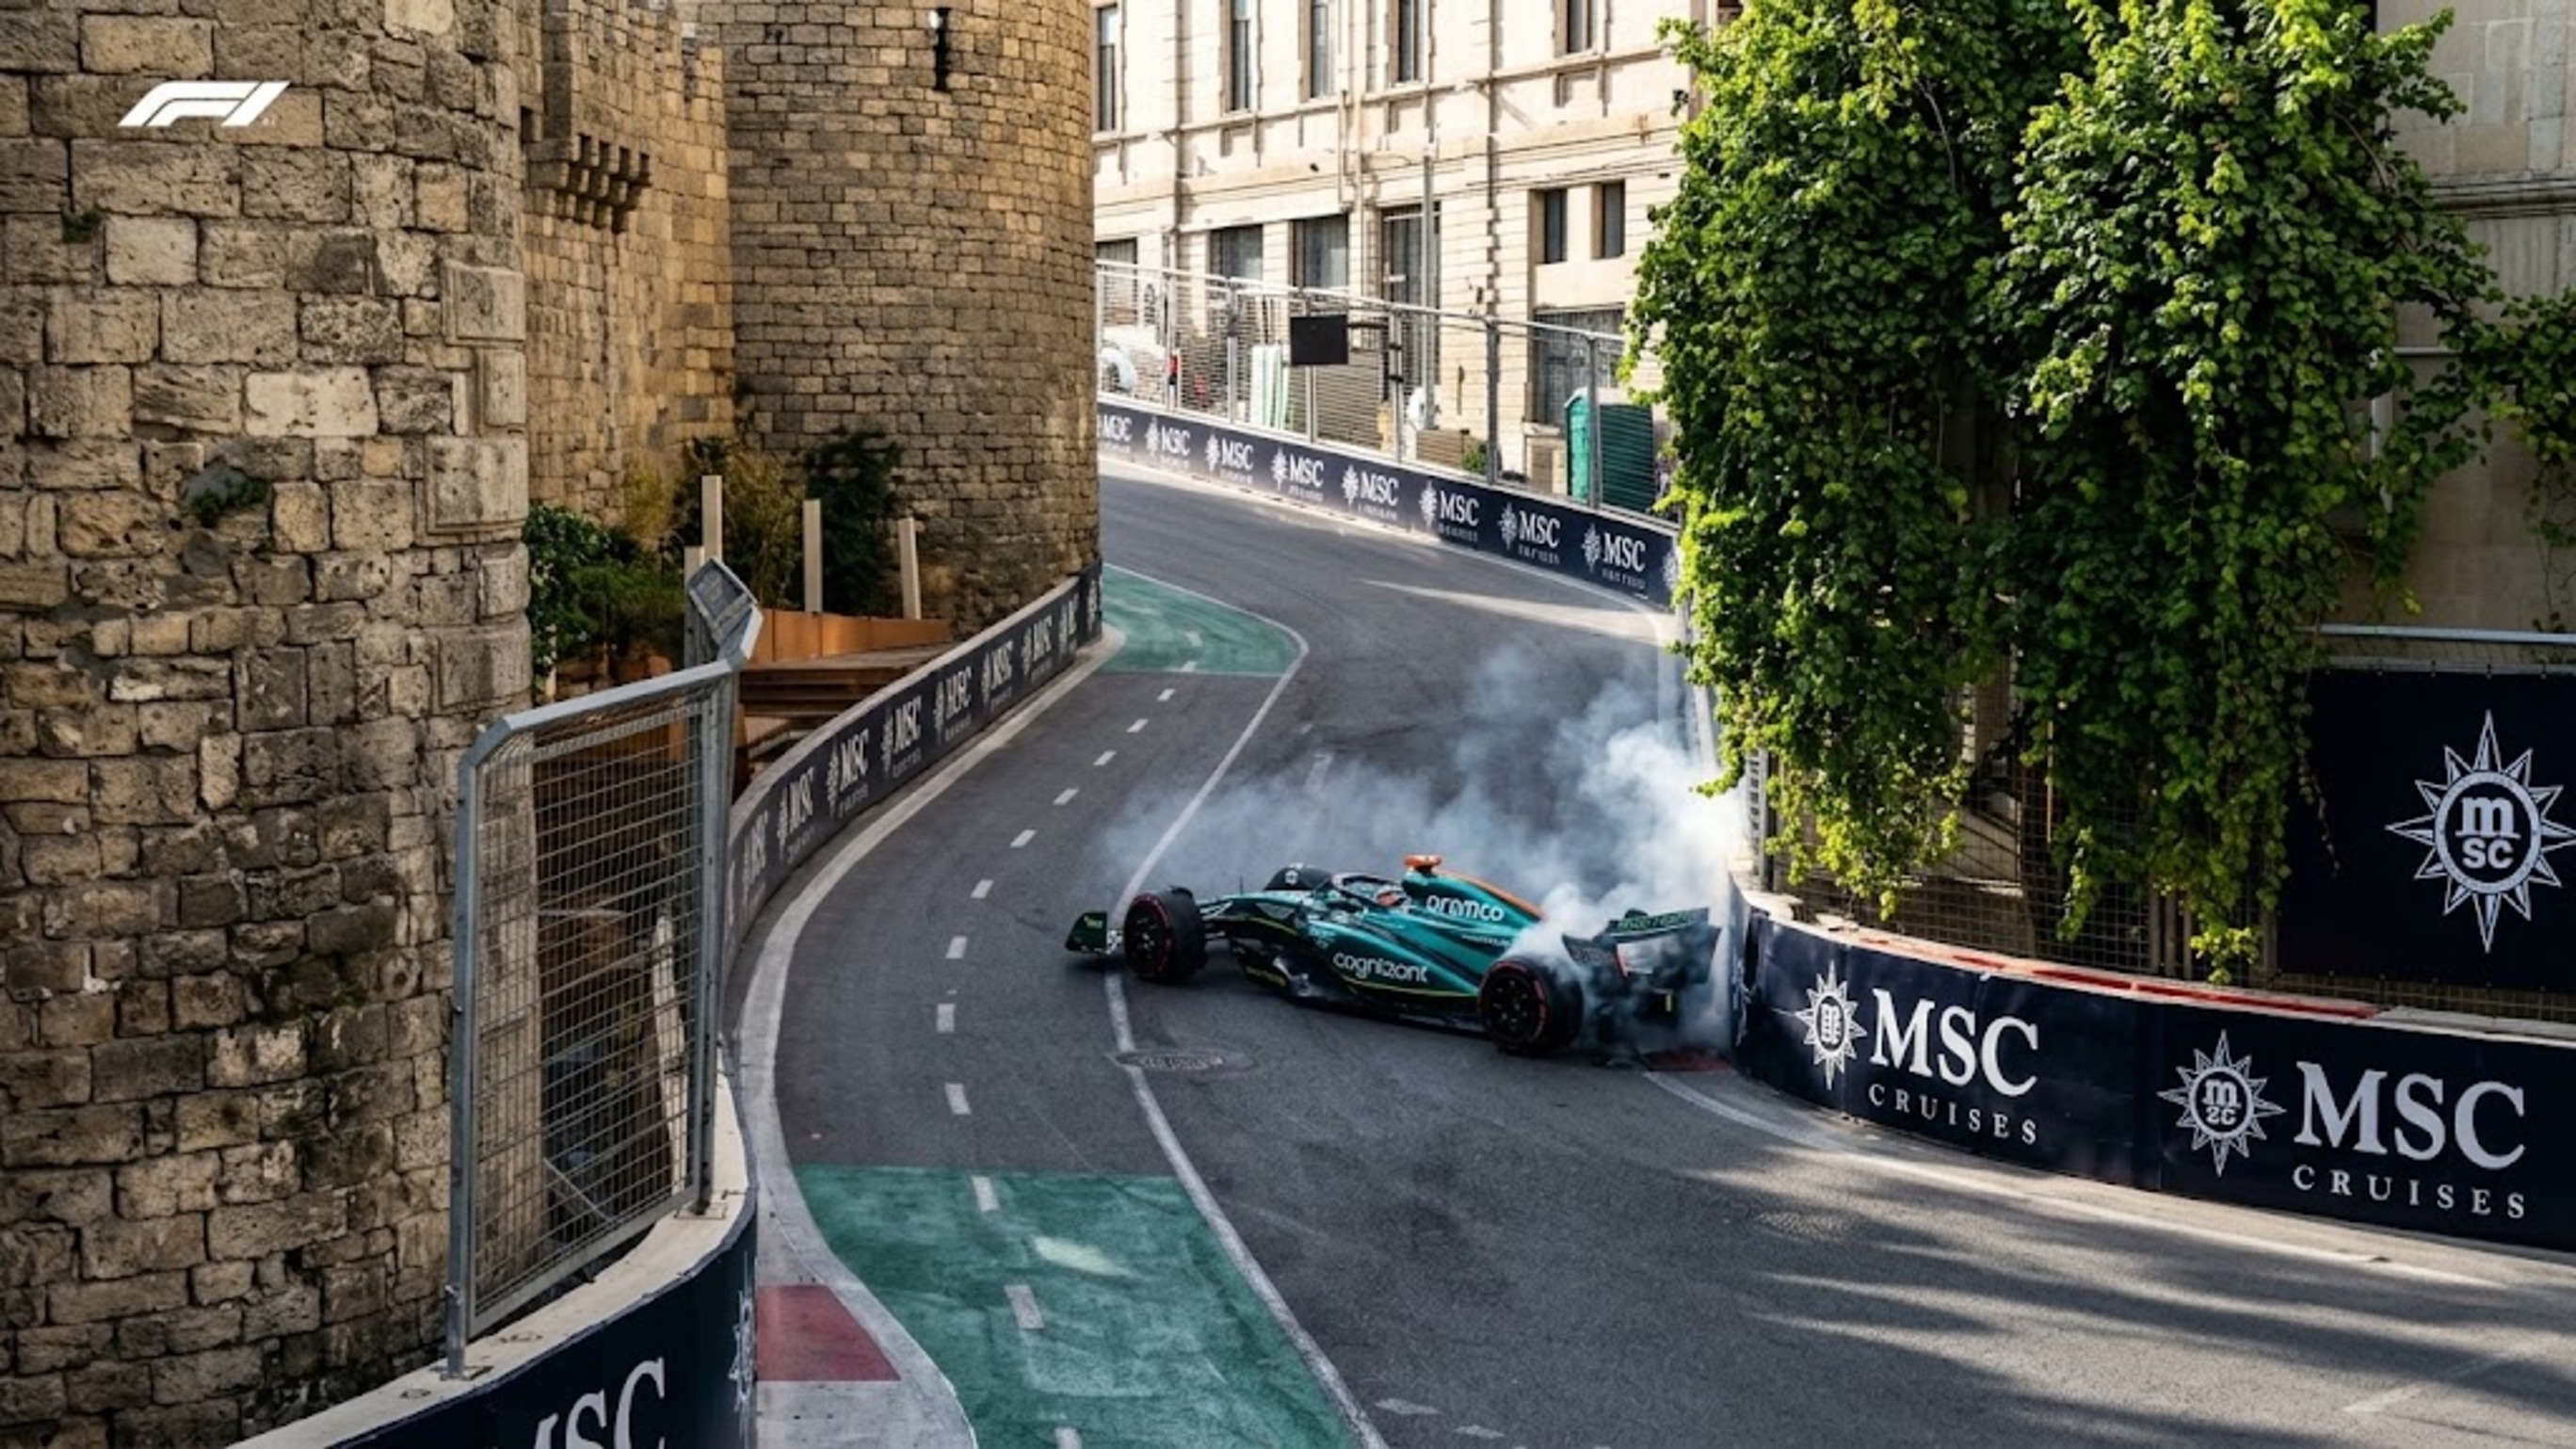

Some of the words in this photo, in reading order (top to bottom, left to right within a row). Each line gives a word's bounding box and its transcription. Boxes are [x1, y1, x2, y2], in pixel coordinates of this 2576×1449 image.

[1222, 438, 1253, 470] MSC
[1290, 454, 1324, 487] MSC
[1360, 471, 1399, 506] MSC
[1441, 490, 1479, 525] MSC
[1519, 510, 1560, 548] MSC
[1603, 533, 1646, 572] MSC
[1332, 951, 1428, 982] cognizant
[1870, 989, 2039, 1097] MSC
[1868, 1084, 2037, 1145] CRUISES
[2294, 1061, 2525, 1169] MSC
[2293, 1165, 2524, 1218] CRUISES
